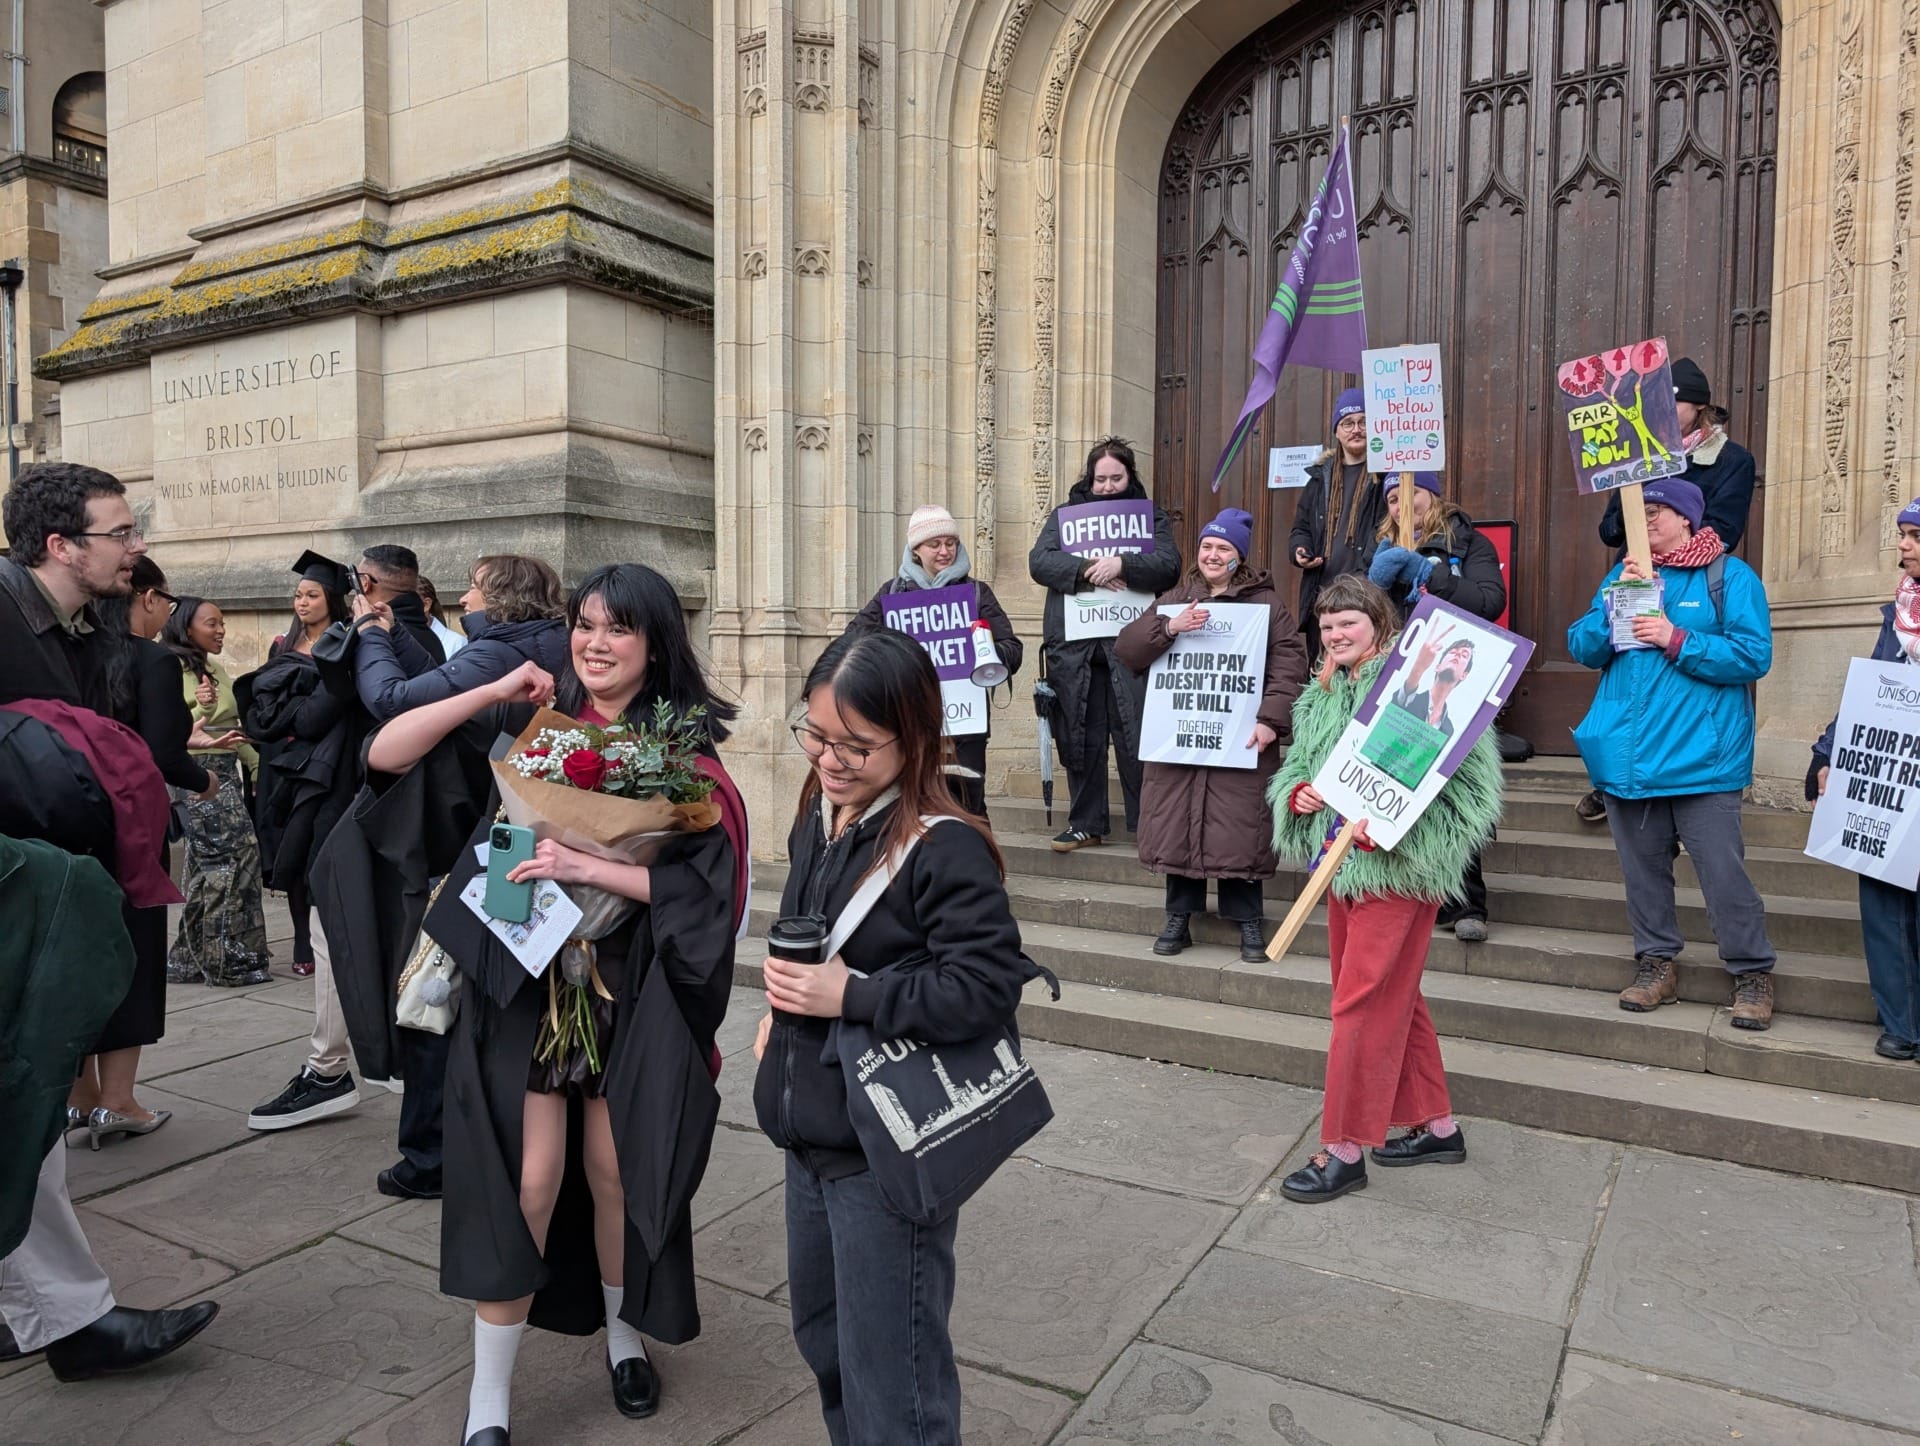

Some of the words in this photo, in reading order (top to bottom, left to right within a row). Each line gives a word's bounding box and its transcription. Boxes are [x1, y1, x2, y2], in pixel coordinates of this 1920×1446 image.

[164, 358, 299, 404] UNIVERSITY
[309, 350, 341, 380] OF
[1374, 359, 1399, 375] Our
[1406, 359, 1432, 383] pay
[1375, 382, 1396, 400] has
[1405, 382, 1435, 396] been
[1388, 397, 1433, 414] below
[1573, 405, 1611, 425] FAIR
[206, 415, 301, 451] BRISTOL
[1374, 415, 1440, 439] inflation
[1582, 419, 1619, 443] PAY
[1396, 434, 1417, 450] for
[1581, 440, 1631, 468] NOW
[1384, 448, 1431, 470] years
[1592, 455, 1683, 490] WAGES
[161, 482, 194, 500] WILLS
[199, 473, 273, 496] MEMORIAL
[278, 464, 348, 489] BUILDING
[1062, 514, 1153, 546] OFFICIAL
[886, 601, 974, 634] OFFICIAL
[922, 637, 967, 667] KET
[1167, 653, 1181, 670] IF
[1183, 653, 1214, 671] OUR
[1217, 654, 1247, 673] PAY
[1155, 673, 1218, 691] DOESN'T
[1221, 674, 1256, 694] RISE
[1173, 693, 1193, 710] WE
[1197, 694, 1232, 713] WILL
[1177, 719, 1223, 735] TOGETHER
[1176, 734, 1193, 748] WE
[1195, 735, 1222, 750] RISE
[1850, 723, 1866, 746] IF
[1865, 726, 1898, 755] OUR
[1899, 733, 1920, 762] PA
[1836, 747, 1898, 782] DOESN'T
[1897, 760, 1920, 792] RI
[1338, 759, 1410, 821] UNISON
[1846, 776, 1866, 802] WE
[1867, 782, 1904, 813] WILL
[1846, 812, 1890, 839] TOGETHER
[1841, 829, 1859, 849] WE
[1859, 834, 1887, 858] RISE
[856, 1048, 876, 1068] THE
[857, 1054, 886, 1083] BRAND
